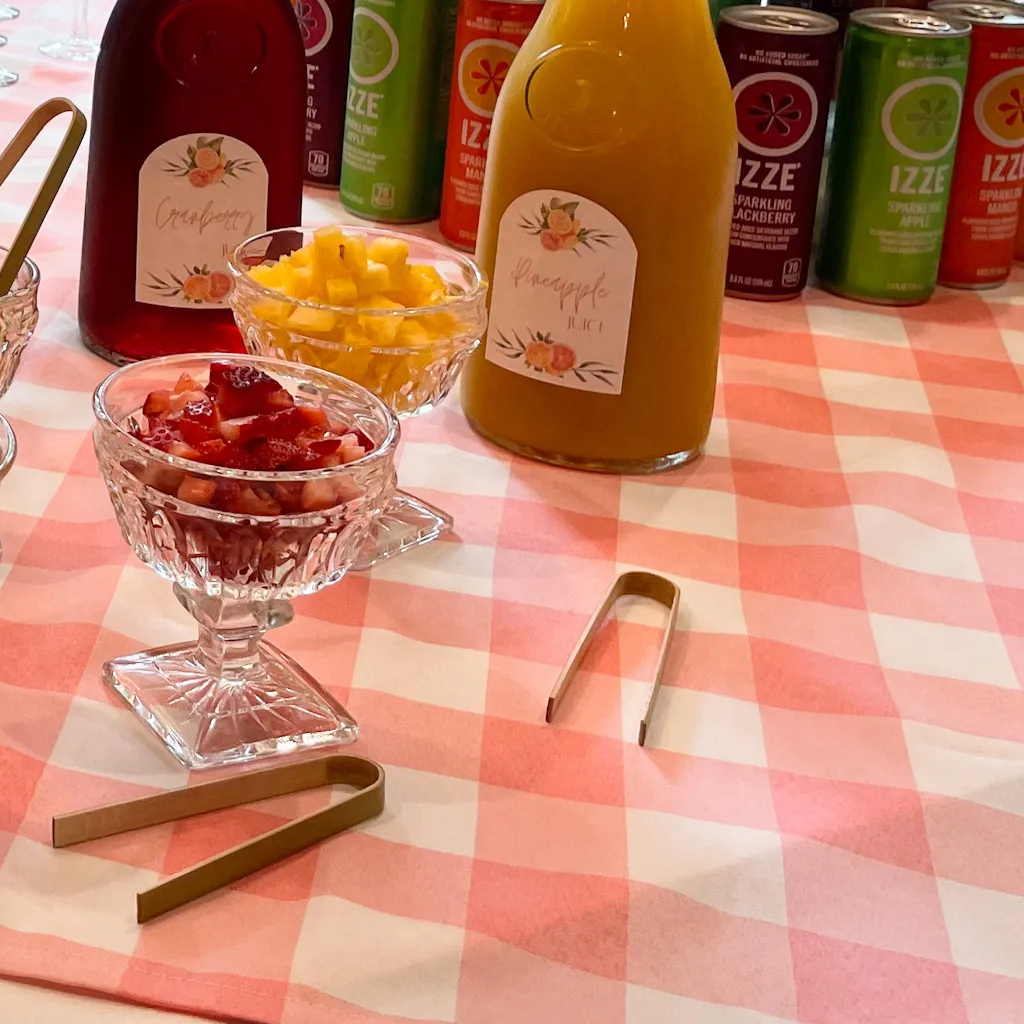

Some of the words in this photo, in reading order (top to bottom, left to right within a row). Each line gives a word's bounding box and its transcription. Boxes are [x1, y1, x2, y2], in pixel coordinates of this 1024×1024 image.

[461, 118, 490, 150] IZ
[313, 153, 324, 165] 70
[736, 157, 797, 191] IZZE
[890, 164, 948, 194] IZZE
[155, 196, 258, 234] Cranberry
[734, 194, 792, 211] SPARKLING
[734, 208, 796, 224] ACKBERRY
[788, 262, 799, 273] 70
[511, 255, 610, 313] Pineapple
